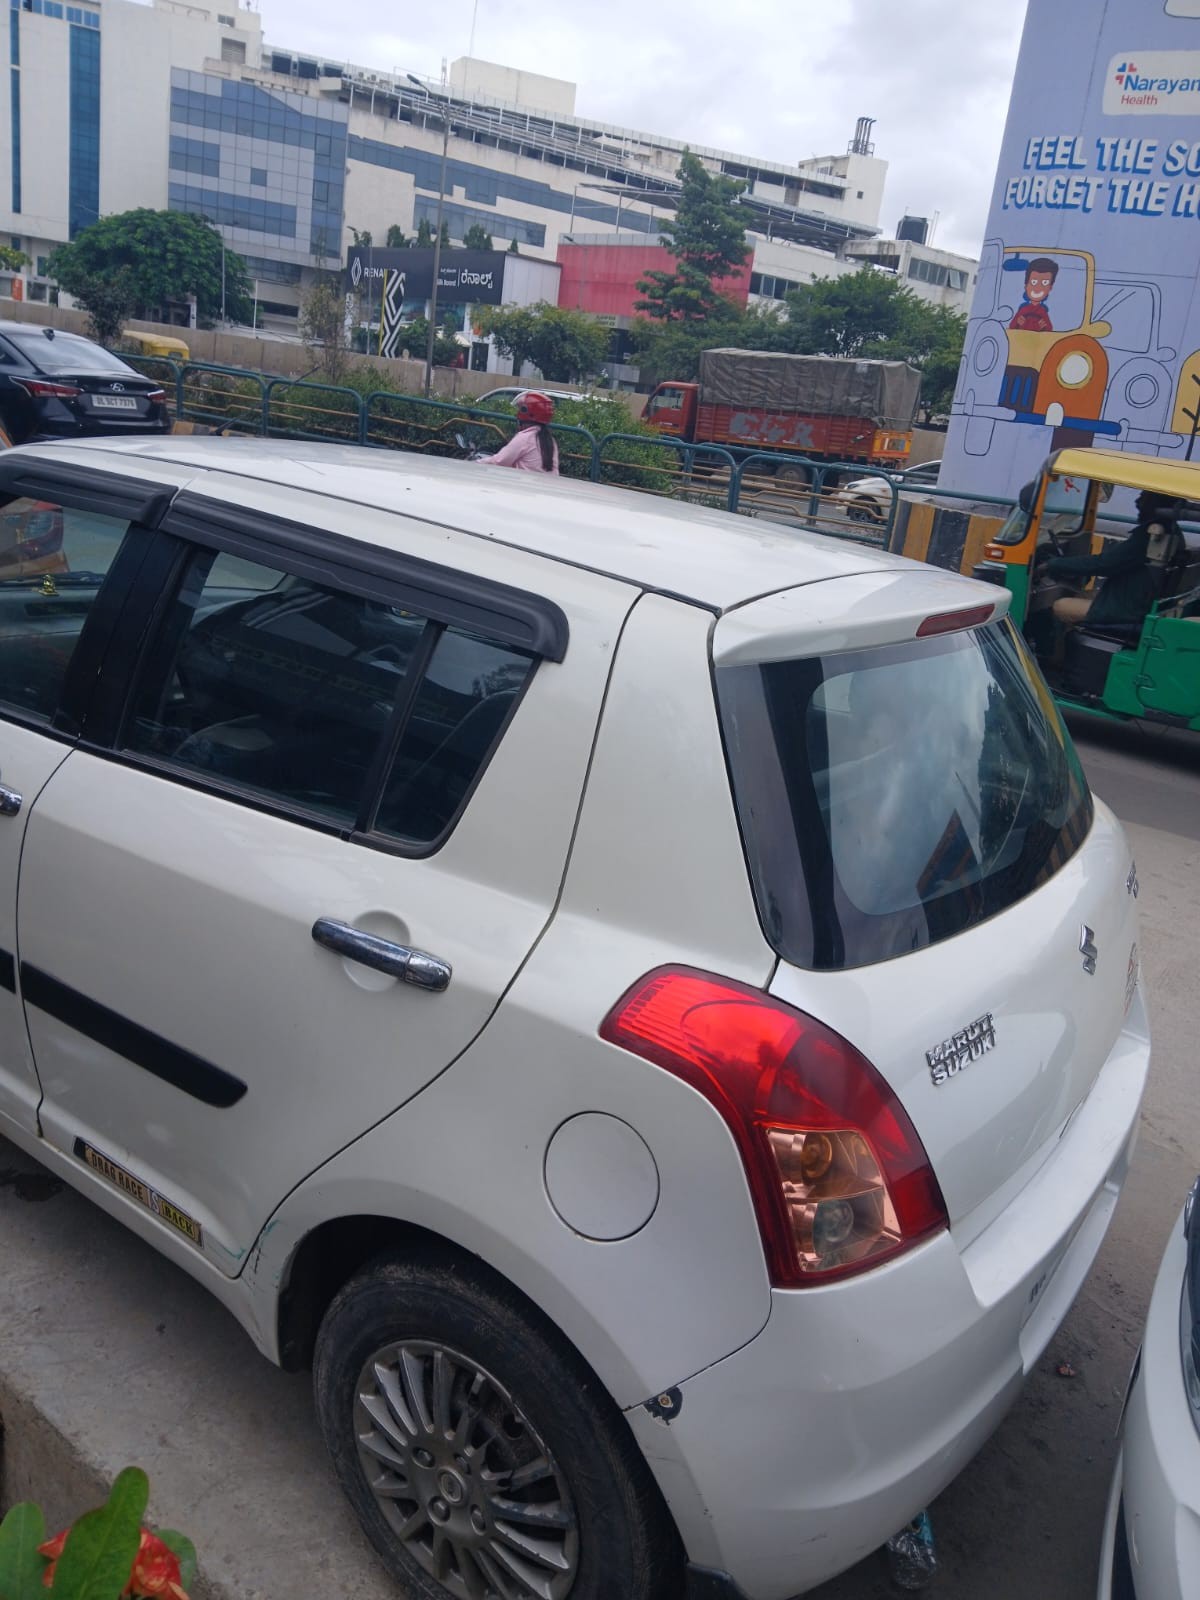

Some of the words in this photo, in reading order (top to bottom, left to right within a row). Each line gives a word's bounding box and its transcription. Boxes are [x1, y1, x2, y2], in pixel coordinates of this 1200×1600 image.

[1120, 94, 1158, 106] Health
[1023, 135, 1089, 170] FEEL
[1096, 136, 1159, 174] THE
[1002, 174, 1104, 213] FORGET
[1107, 178, 1171, 217] THE
[91, 1152, 116, 1182] DRAG
[118, 1171, 144, 1201] RACE
[163, 1202, 193, 1236] BACK
